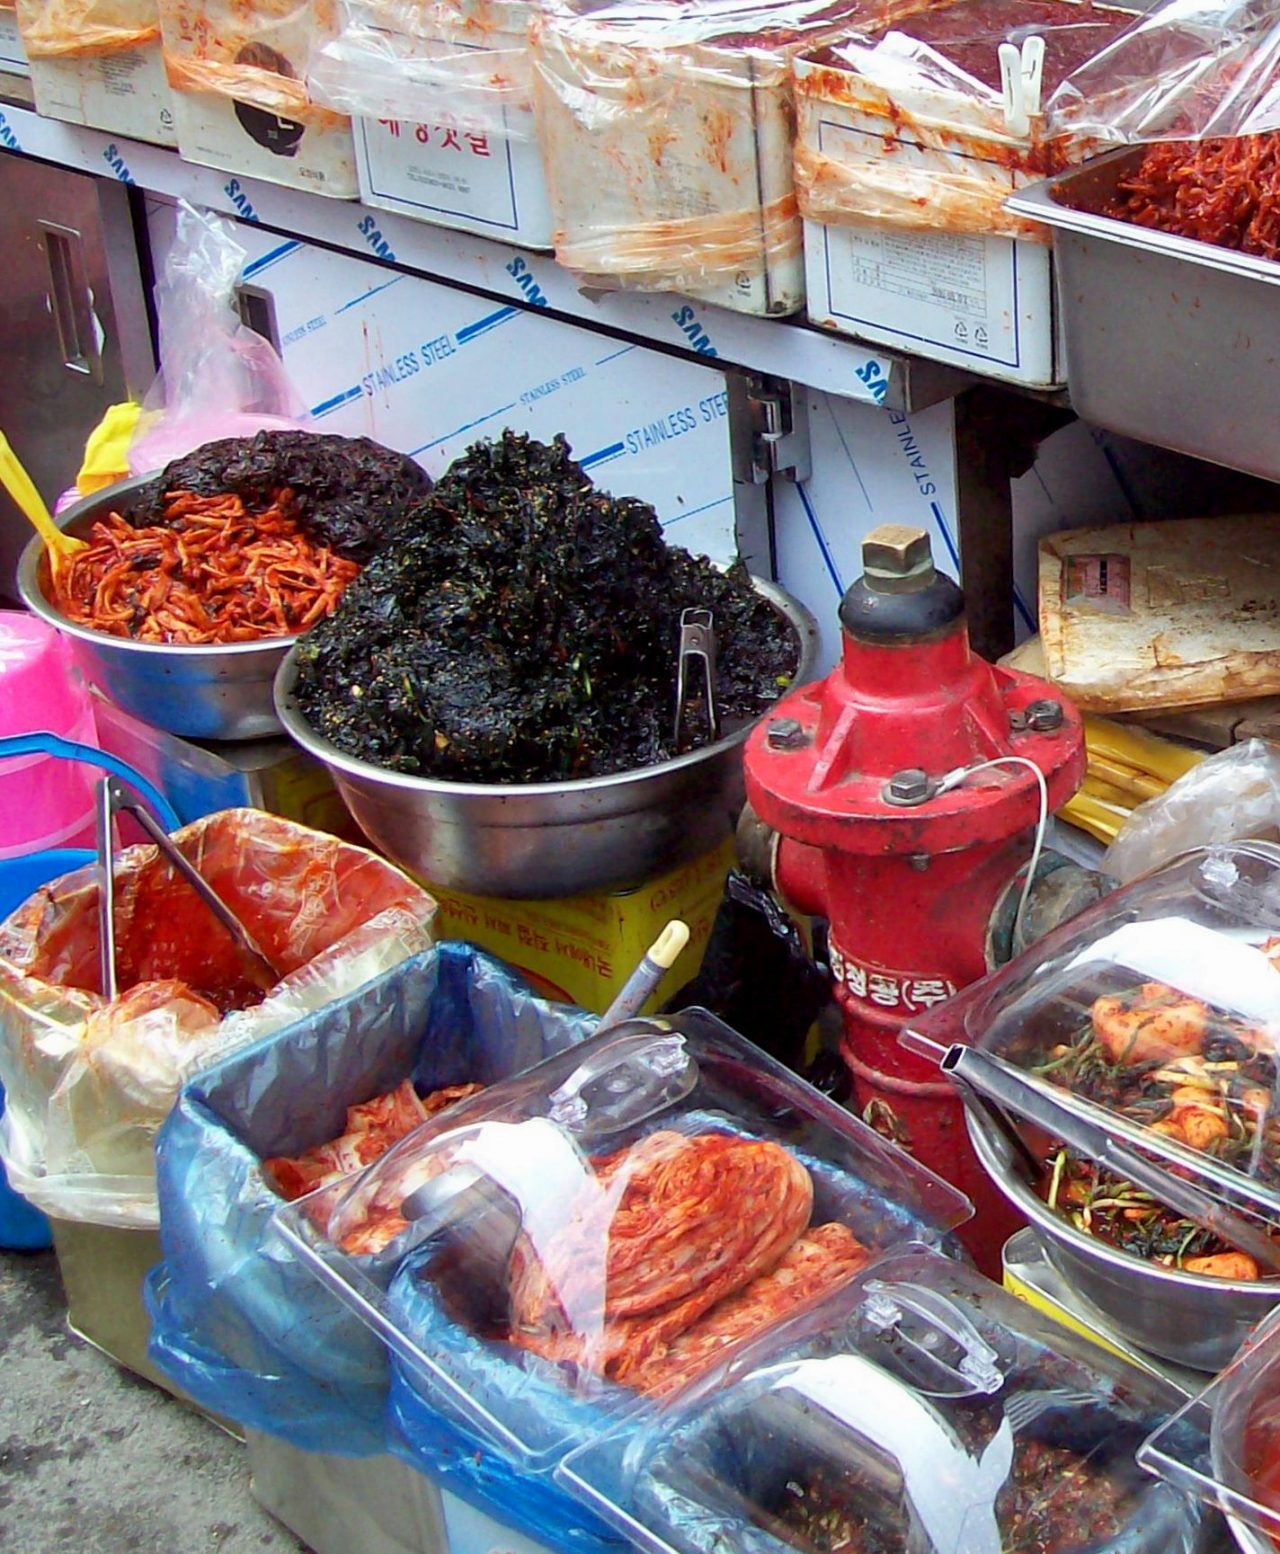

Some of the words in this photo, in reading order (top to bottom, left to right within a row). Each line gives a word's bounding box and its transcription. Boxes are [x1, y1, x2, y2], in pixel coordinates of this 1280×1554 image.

[362, 352, 420, 396] STAINLESS
[421, 335, 457, 366] STEEL
[520, 379, 561, 405] STAINLESS
[562, 367, 587, 386] STEEL
[626, 407, 697, 454] STAINLESS
